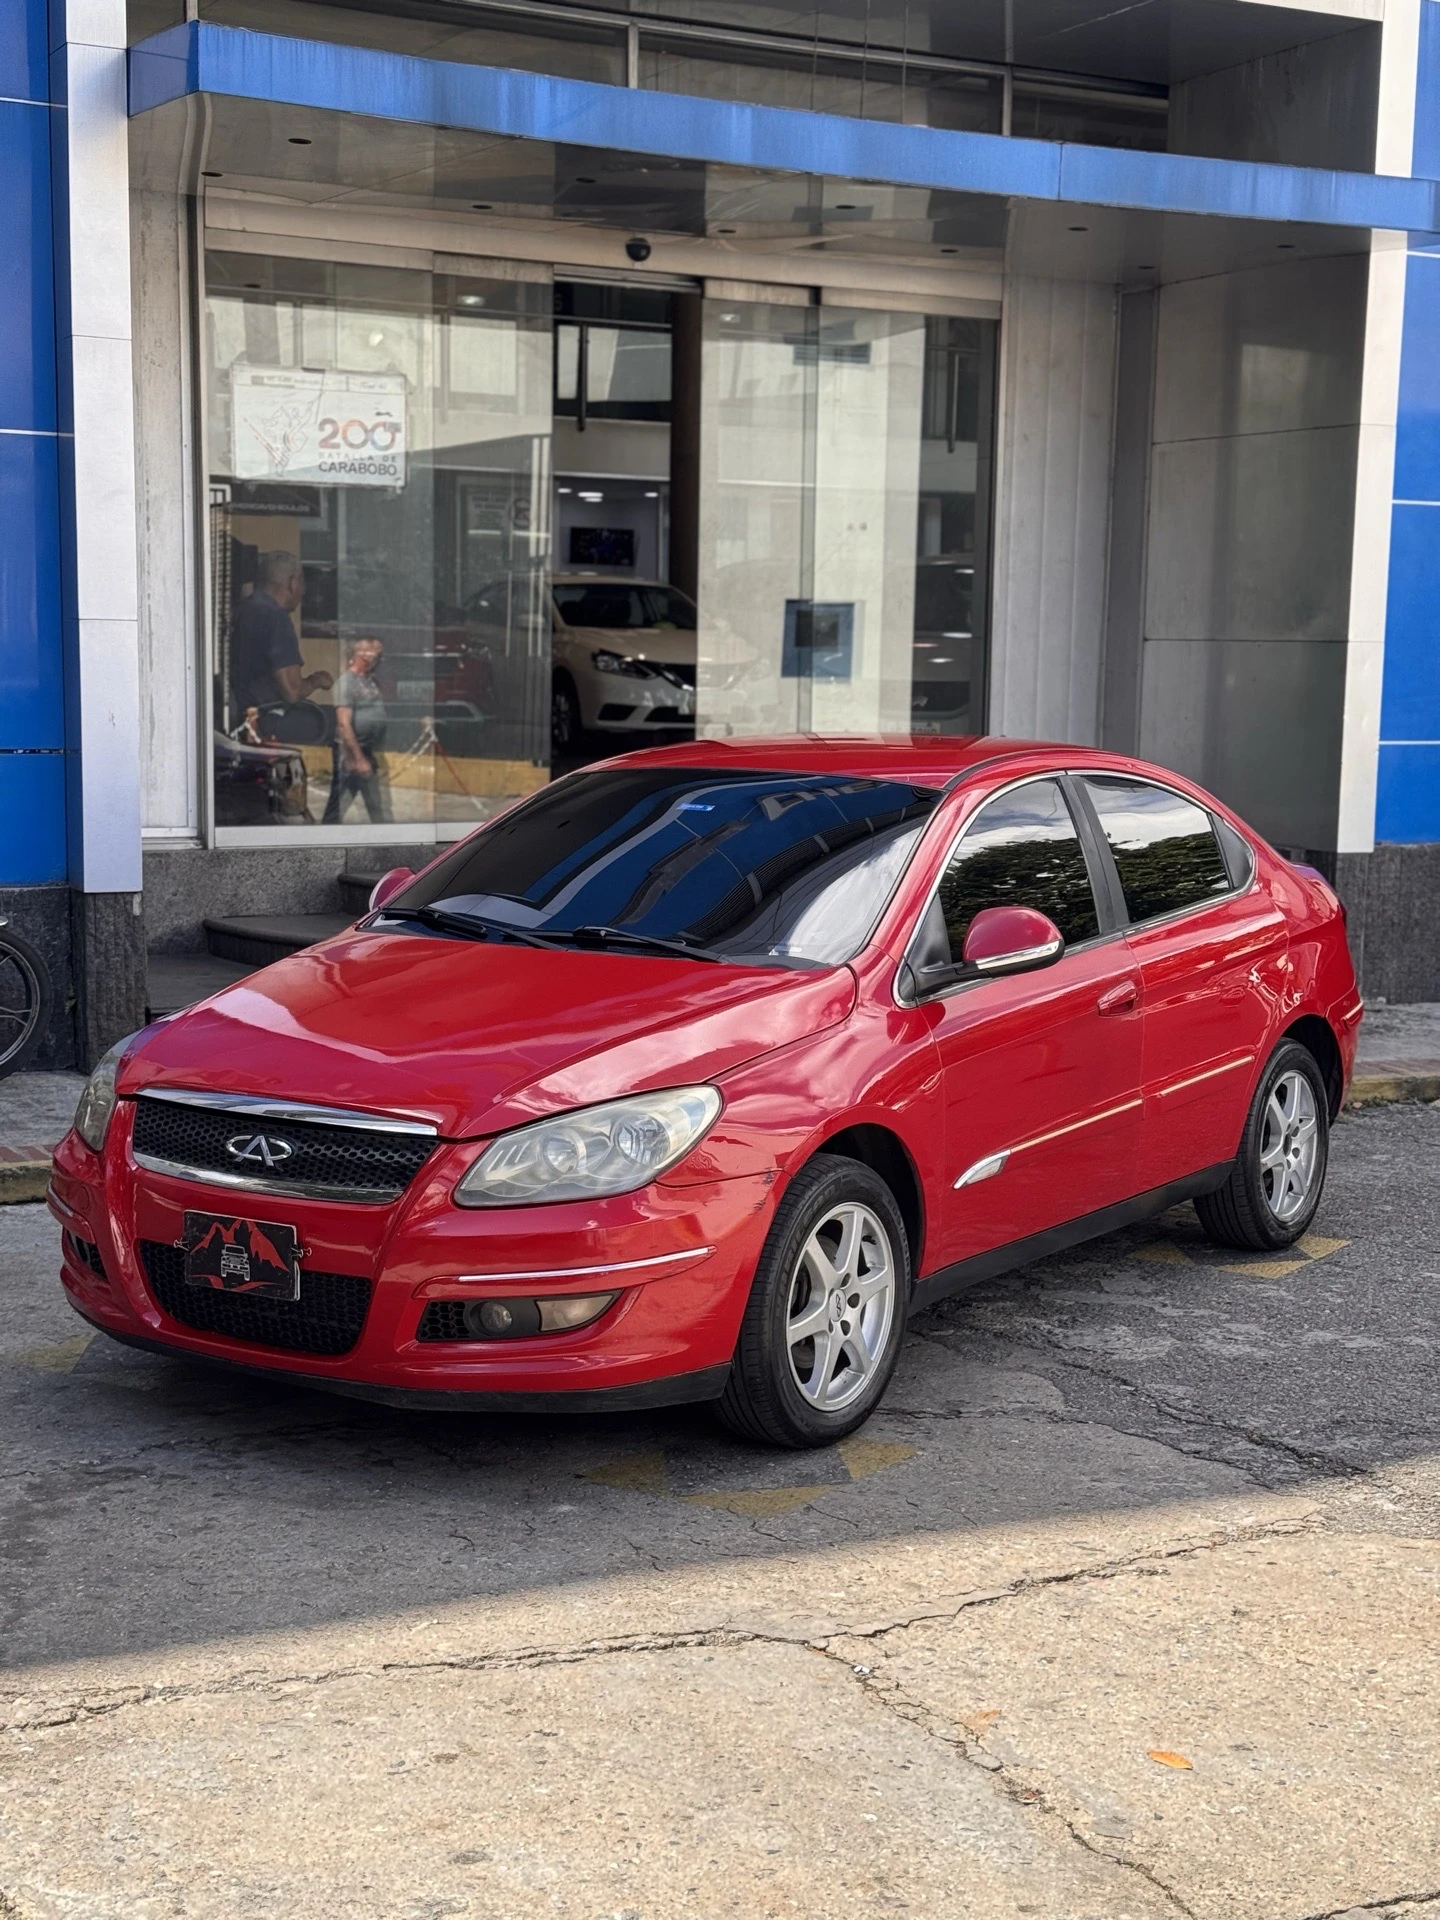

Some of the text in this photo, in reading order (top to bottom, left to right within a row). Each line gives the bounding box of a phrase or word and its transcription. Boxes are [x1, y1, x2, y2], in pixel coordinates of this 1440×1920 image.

[318, 417, 397, 452] 200
[318, 451, 398, 463] BATALLA DE
[318, 461, 398, 477] CARABOBO
